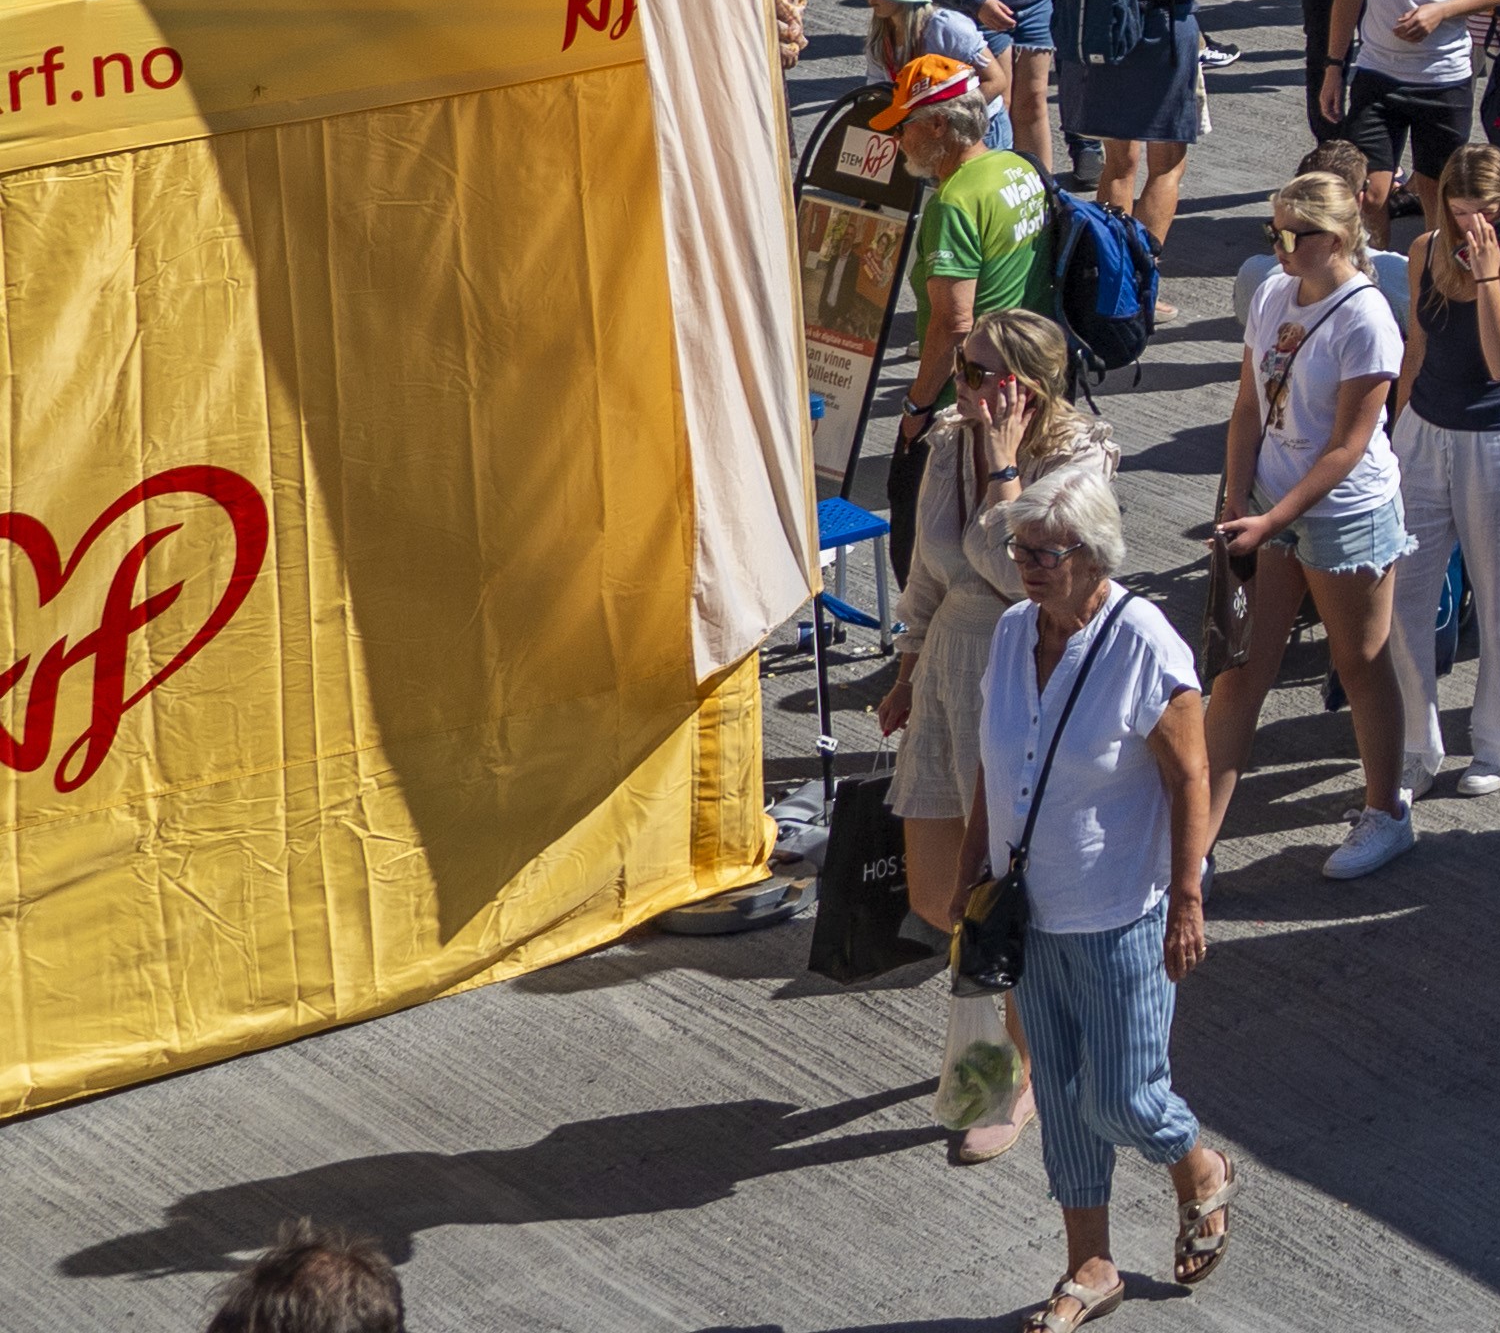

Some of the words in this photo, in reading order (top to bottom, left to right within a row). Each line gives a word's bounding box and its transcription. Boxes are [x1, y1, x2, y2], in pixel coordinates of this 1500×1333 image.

[0, 44, 185, 114] rf.no
[840, 151, 864, 167] STEM
[1003, 166, 1025, 182] The
[1014, 207, 1045, 241] Worl
[824, 350, 852, 371] vinne
[808, 366, 853, 391] billetter!
